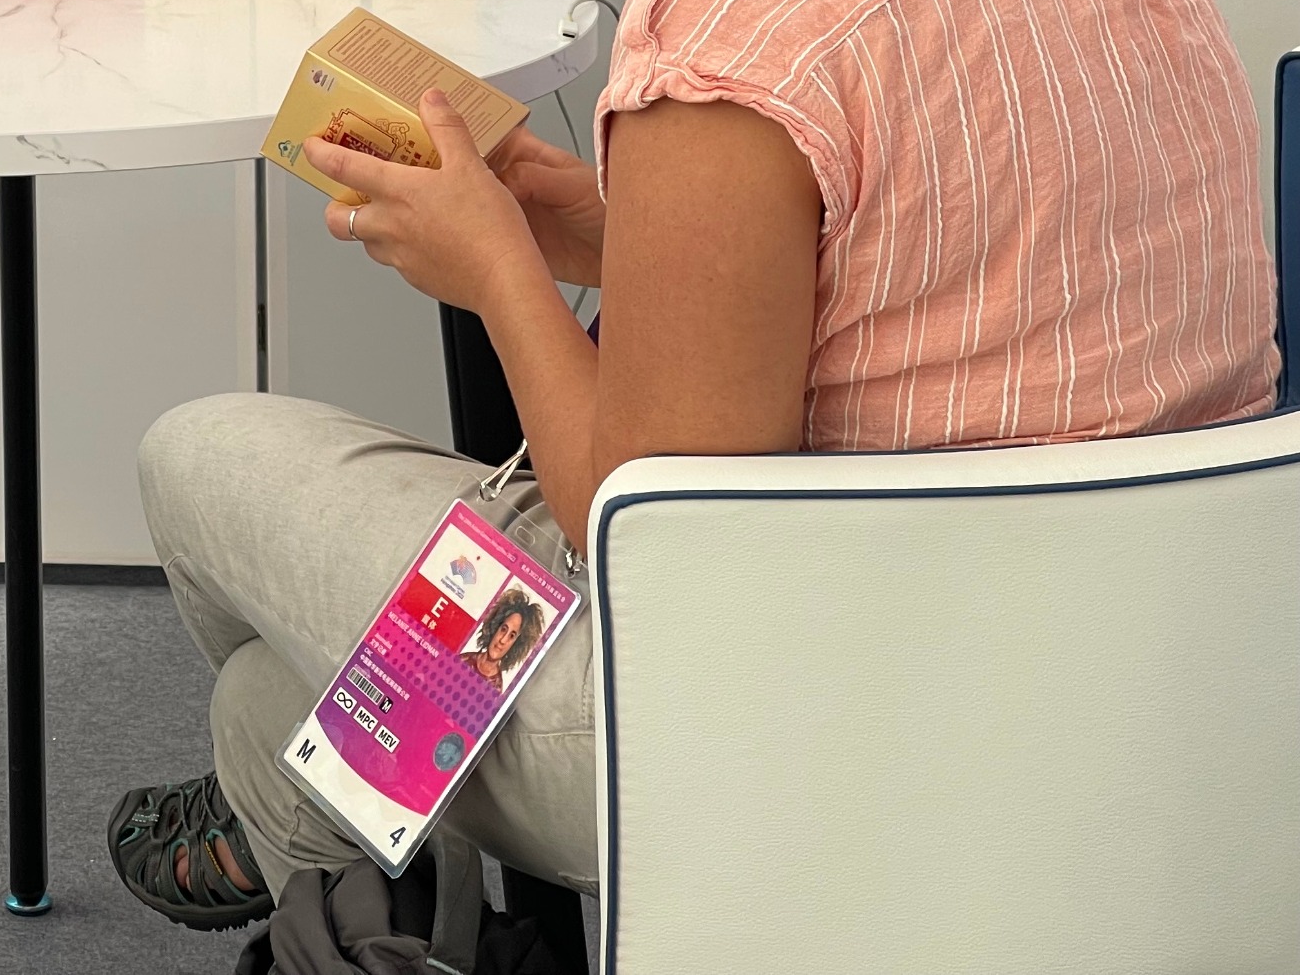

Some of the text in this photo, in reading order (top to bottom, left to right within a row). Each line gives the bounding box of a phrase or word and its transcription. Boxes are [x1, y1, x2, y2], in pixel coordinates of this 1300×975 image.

[431, 596, 449, 618] E
[356, 709, 398, 749] MPC MEV
[296, 738, 317, 764] M
[389, 826, 407, 848] 4
